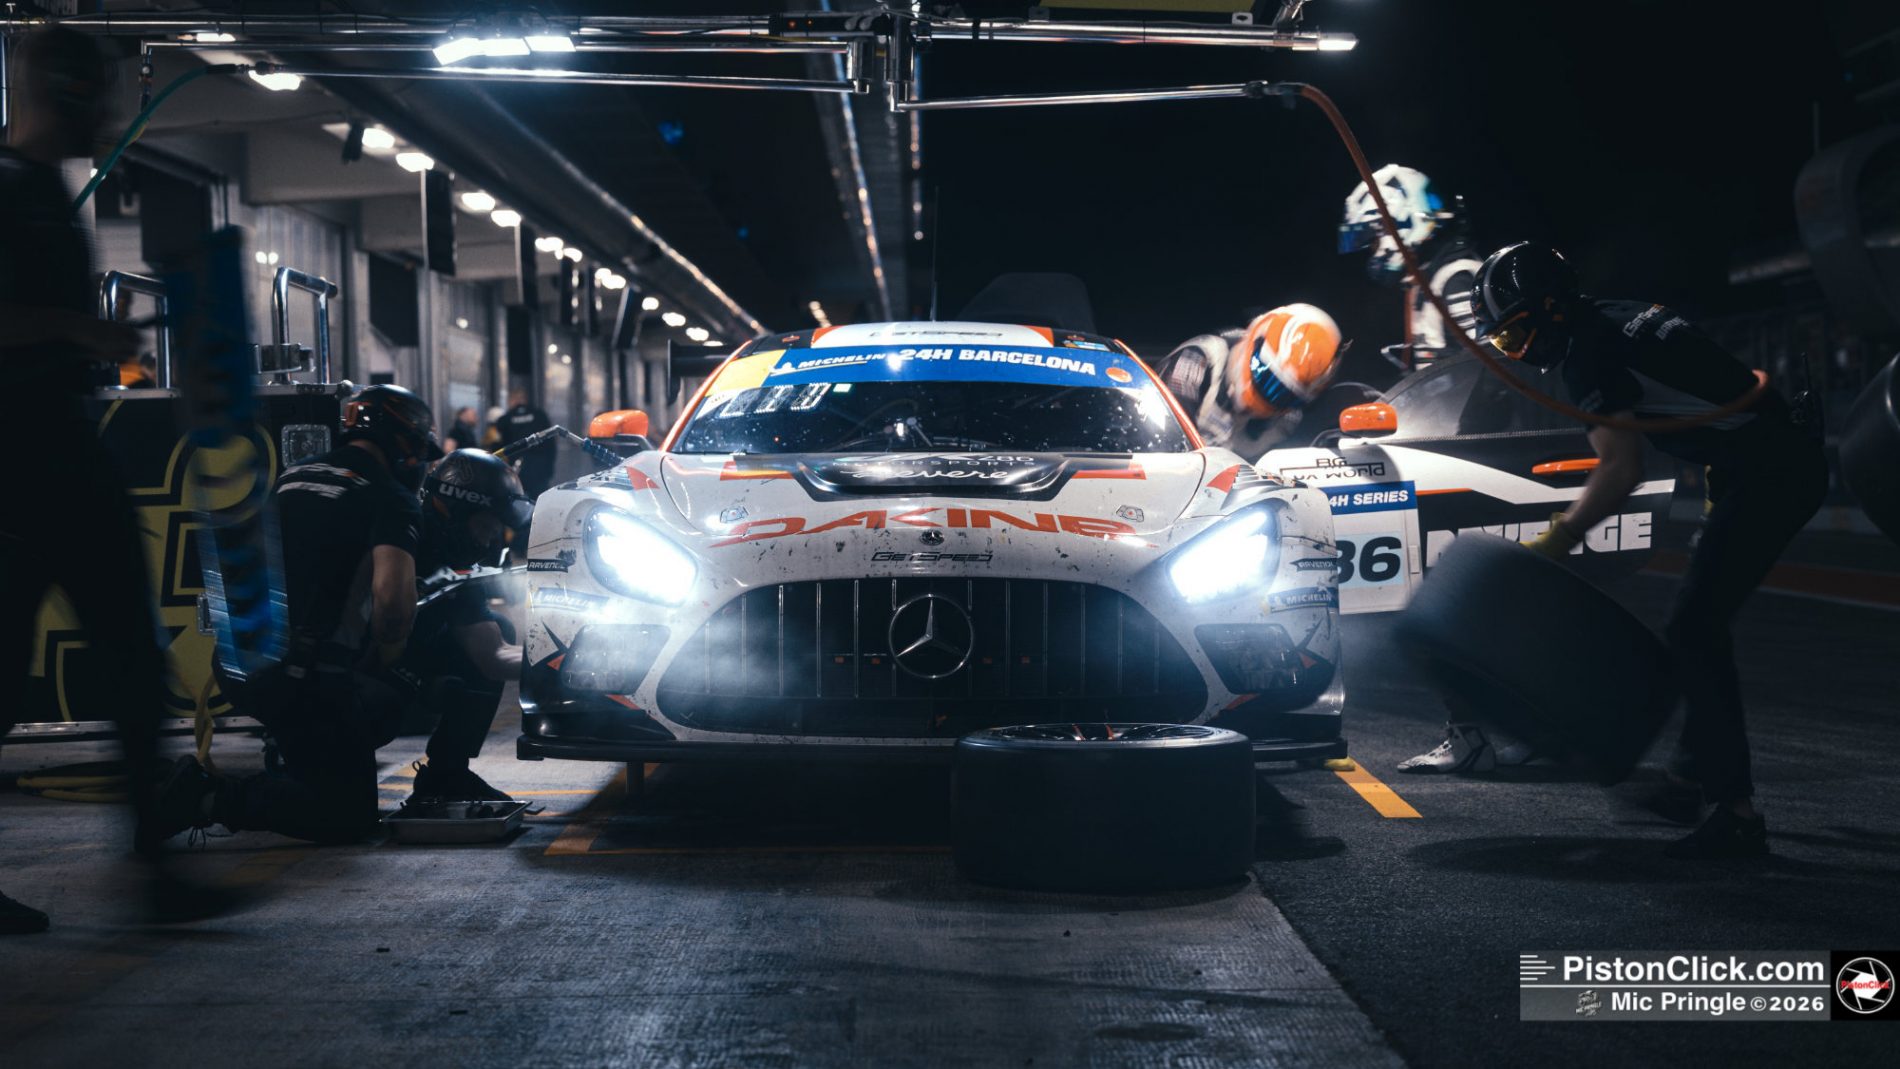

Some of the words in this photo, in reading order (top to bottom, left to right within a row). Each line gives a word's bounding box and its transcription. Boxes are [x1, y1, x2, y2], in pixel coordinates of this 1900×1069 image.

[797, 353, 886, 369] MICHELIN
[900, 348, 952, 361] 24H
[958, 349, 1096, 376] BARCELONA
[438, 483, 494, 507] uvex
[1353, 489, 1409, 506] SERIES
[706, 506, 1160, 549] DAKINE
